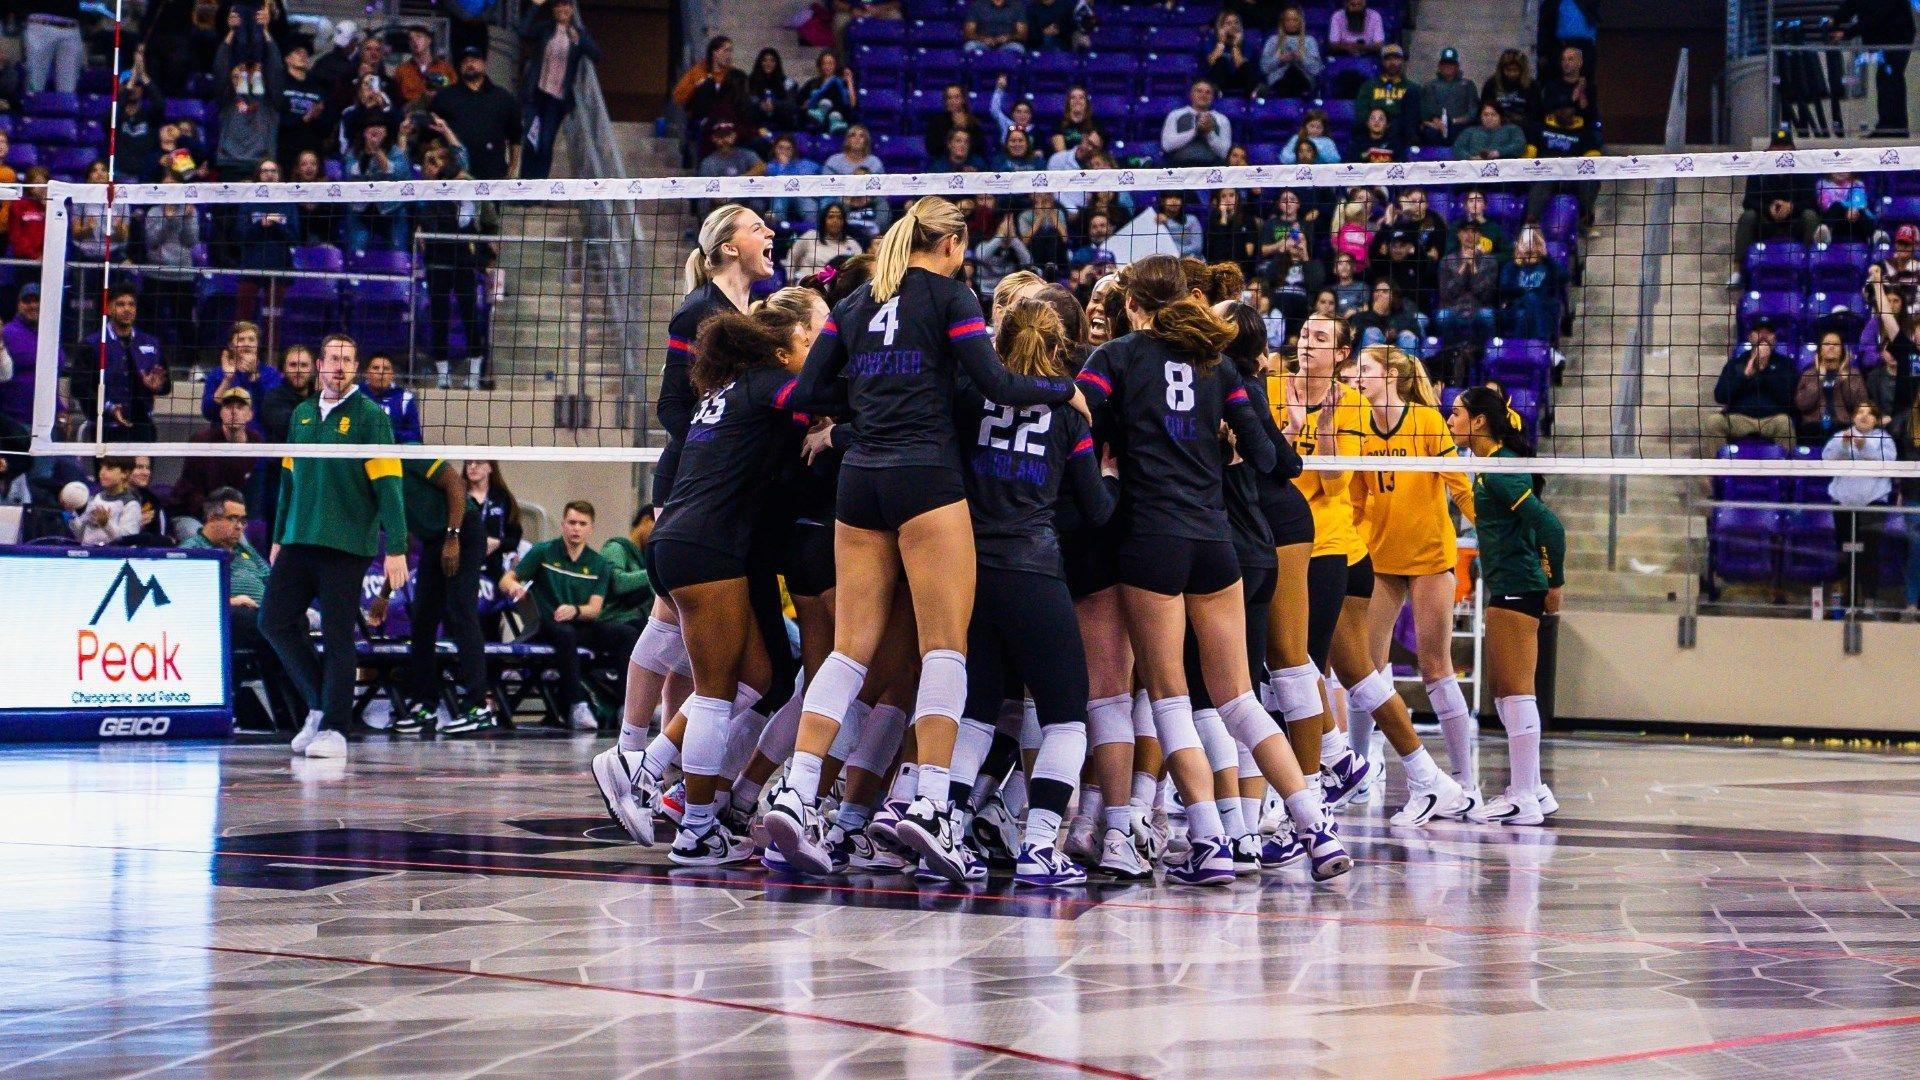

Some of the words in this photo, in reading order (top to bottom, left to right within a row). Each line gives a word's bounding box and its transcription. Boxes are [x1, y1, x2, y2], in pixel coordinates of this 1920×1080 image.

[868, 295, 900, 346] 4
[1164, 360, 1195, 411] 8
[978, 398, 1052, 456] 22
[77, 628, 182, 683] Peak
[137, 691, 156, 703] and
[99, 716, 171, 737] GEICO
